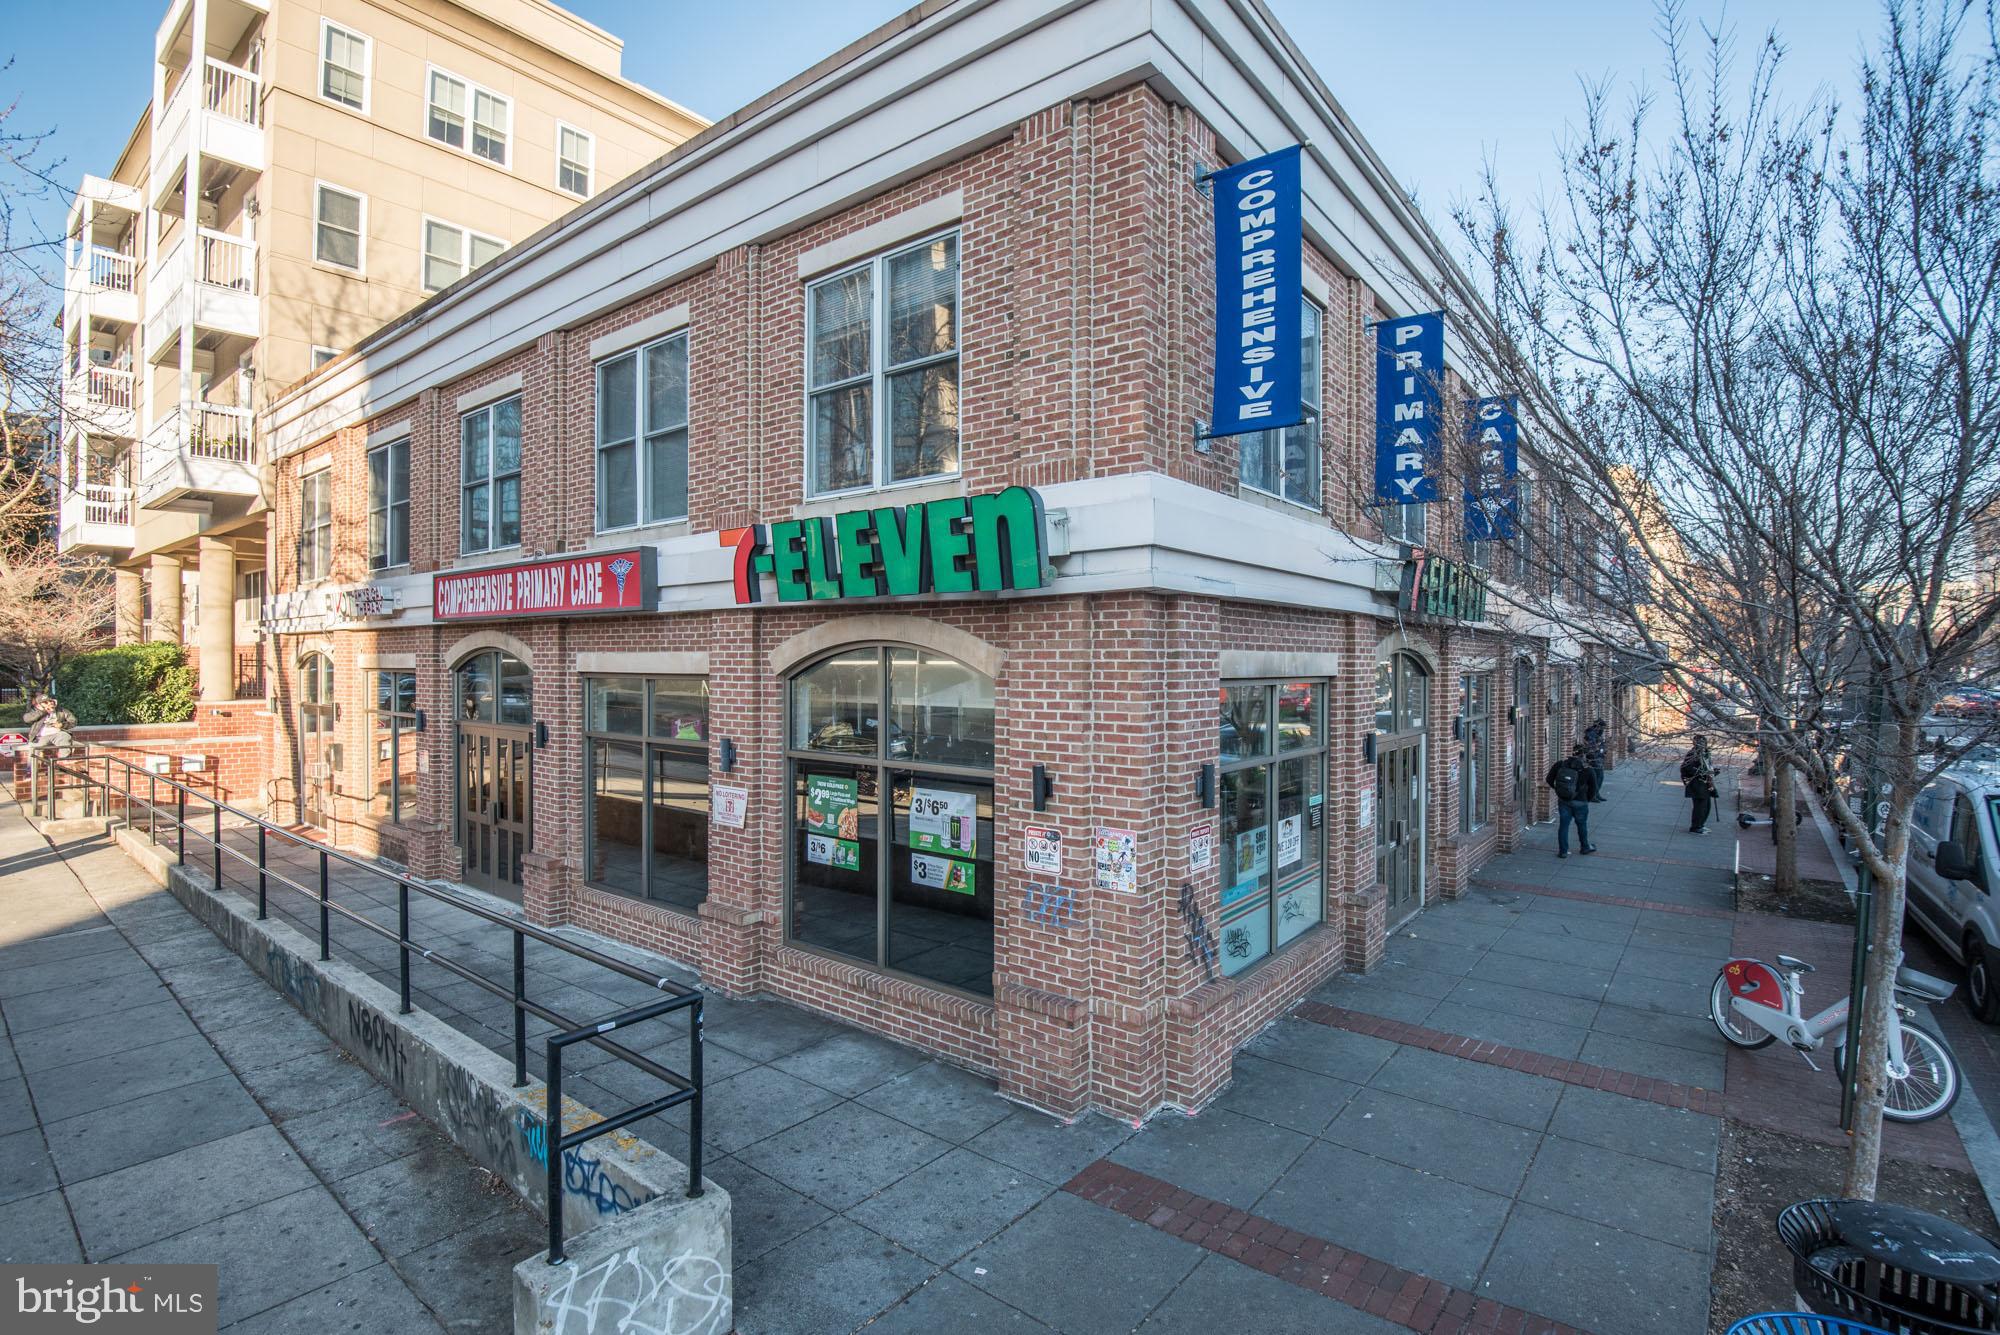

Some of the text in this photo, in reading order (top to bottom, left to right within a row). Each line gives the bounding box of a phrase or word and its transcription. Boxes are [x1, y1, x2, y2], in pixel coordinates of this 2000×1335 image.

[1237, 169, 1277, 420] COMPREHENSIVE
[1394, 324, 1424, 496] PRIMARY
[438, 561, 603, 615] COMPREHENSIVE PRIMARY CARE
[913, 859, 927, 879] $3
[1028, 850, 1040, 863] NO
